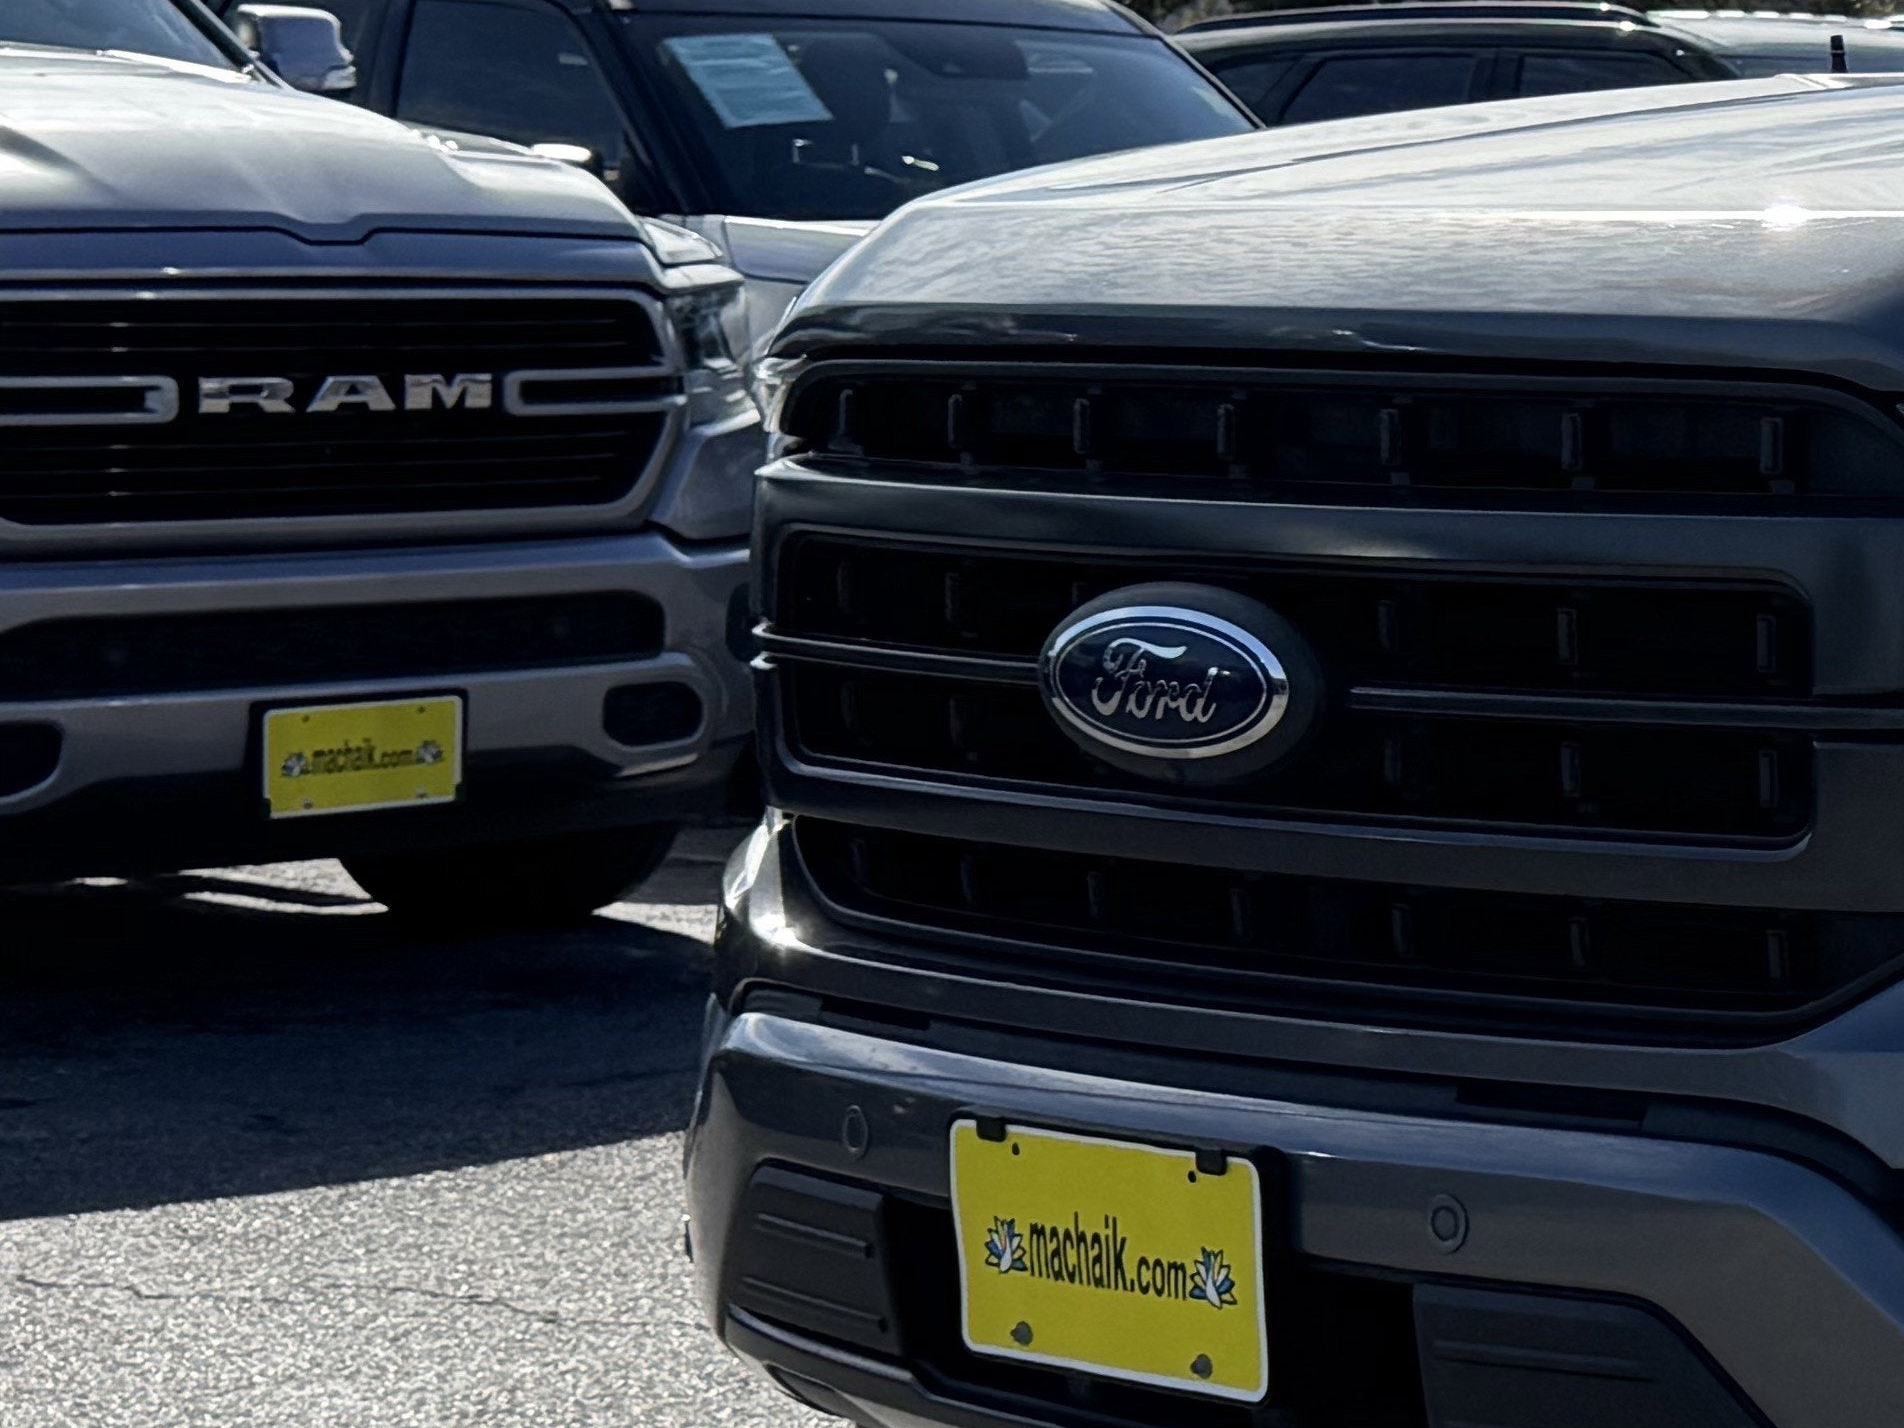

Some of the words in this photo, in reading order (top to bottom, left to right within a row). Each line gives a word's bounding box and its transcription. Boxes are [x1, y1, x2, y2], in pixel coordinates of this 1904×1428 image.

[199, 374, 493, 414] RAM
[1092, 637, 1230, 723] Ford
[311, 738, 414, 774] machaik.com
[1029, 1211, 1188, 1302] machaik.com
